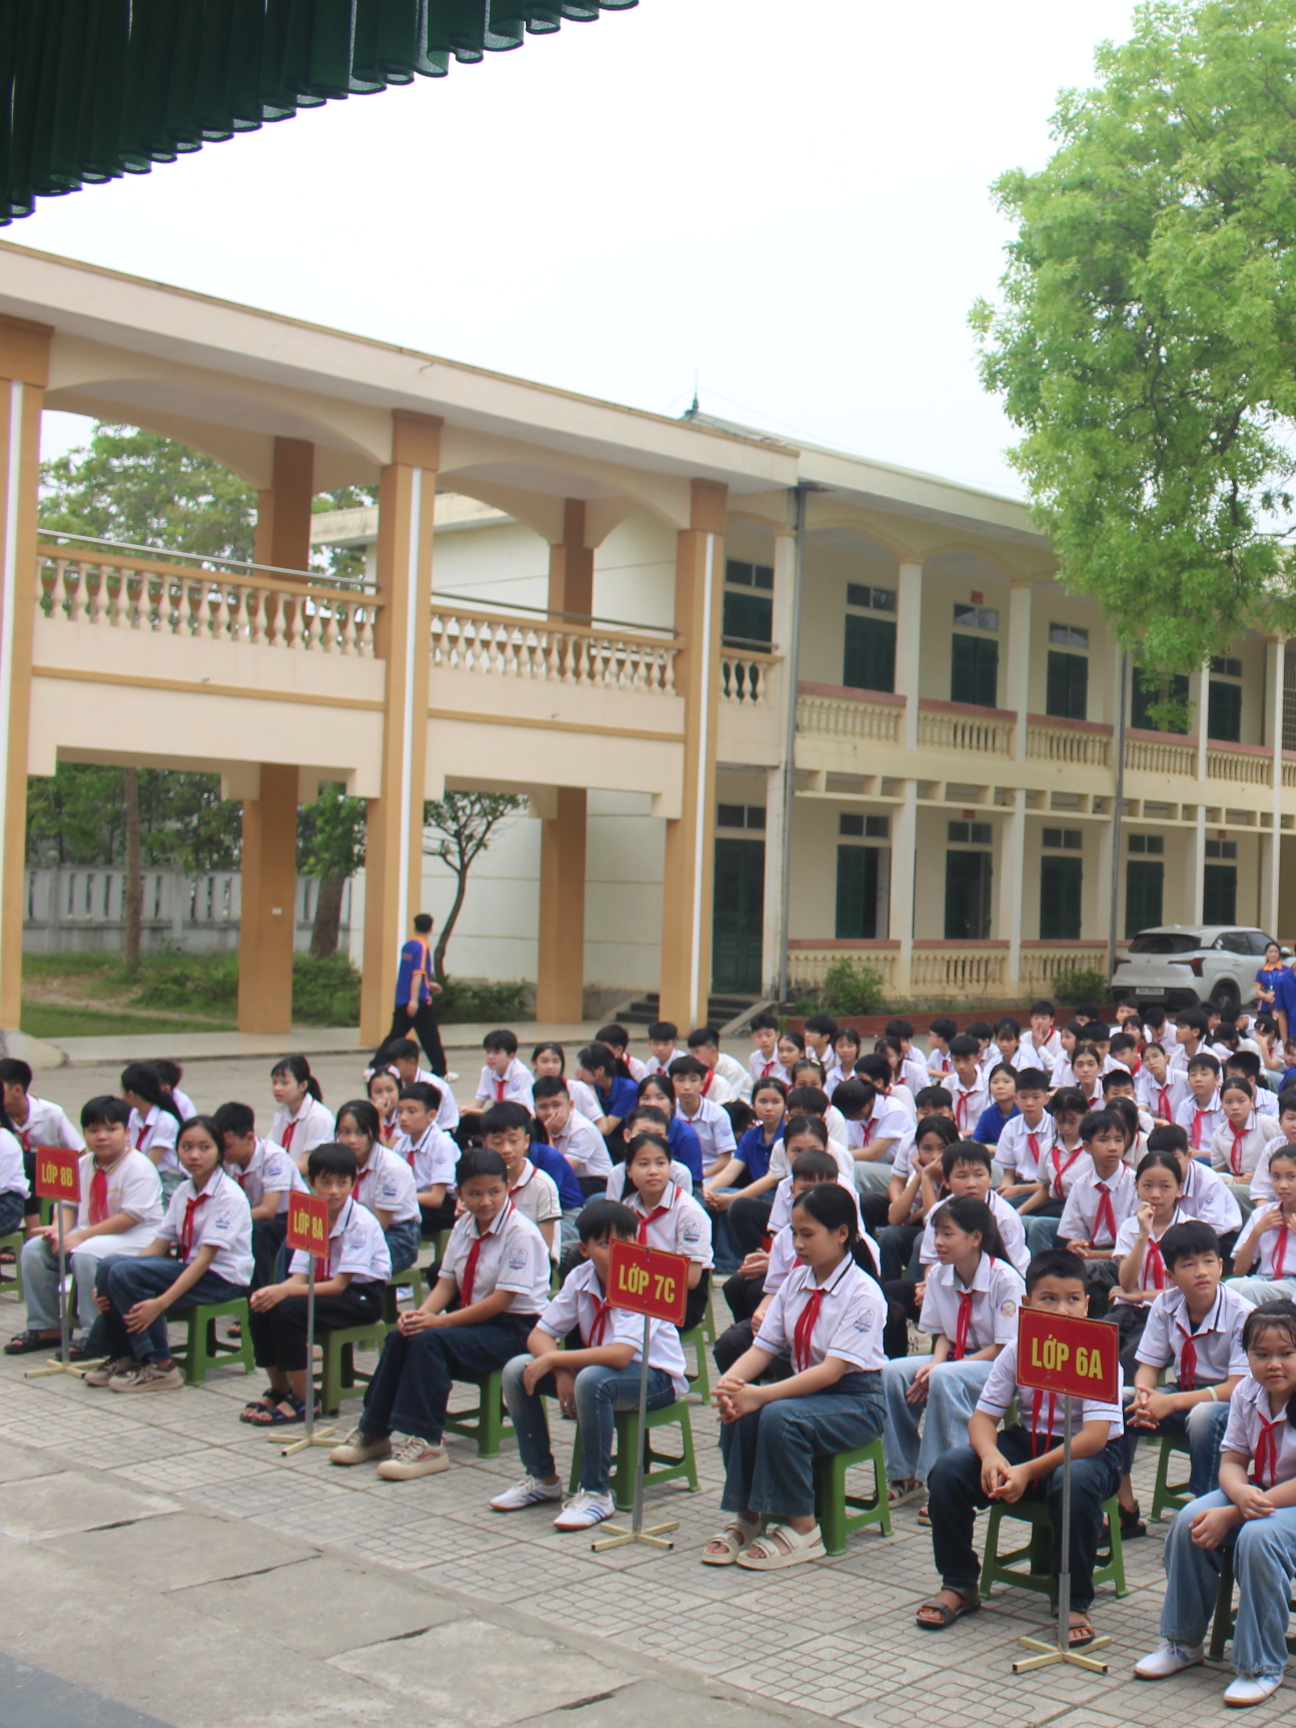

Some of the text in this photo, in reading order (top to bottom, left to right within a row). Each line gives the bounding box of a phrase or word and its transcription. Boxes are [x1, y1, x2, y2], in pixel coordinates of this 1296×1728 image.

[41, 1160, 74, 1187] LỚP 8B
[293, 1208, 324, 1240] LỚP 8A
[618, 1262, 676, 1304] LỚP 7C
[1031, 1334, 1103, 1380] LỚP 6A
